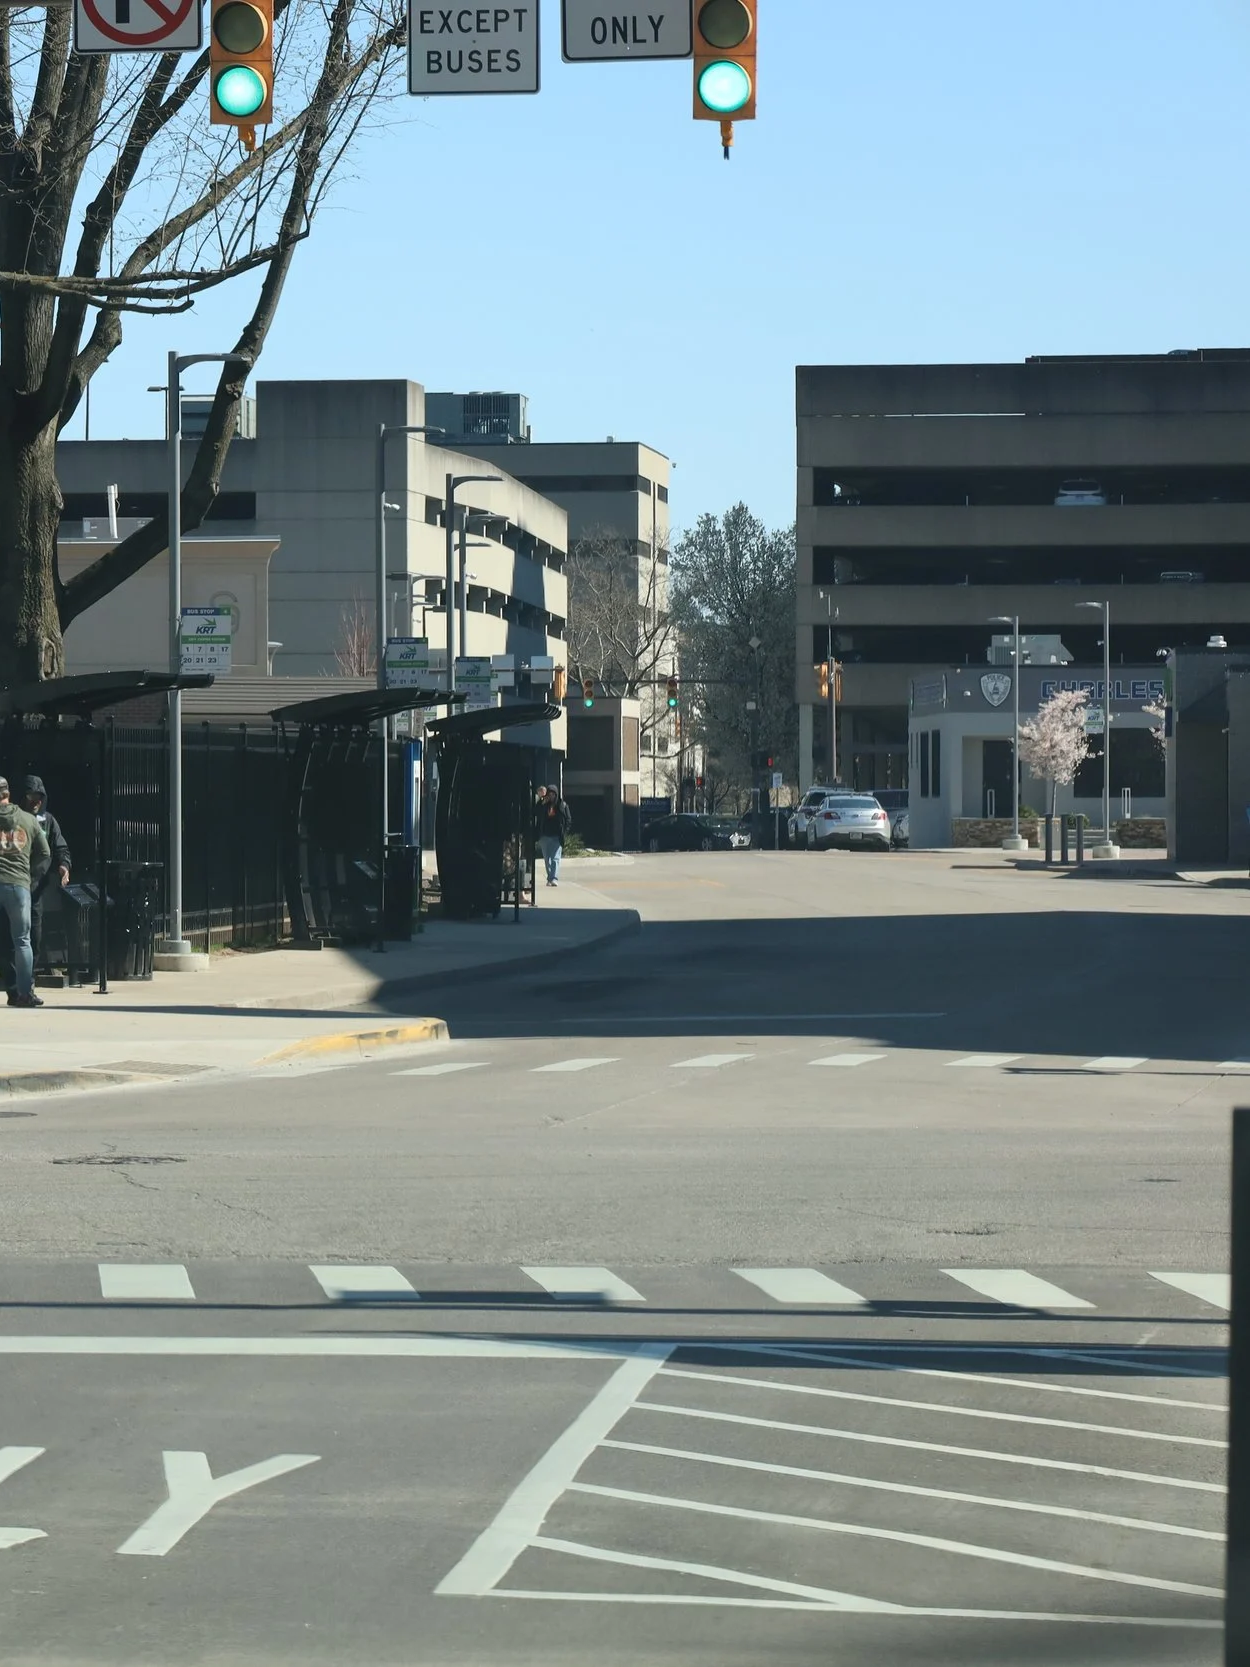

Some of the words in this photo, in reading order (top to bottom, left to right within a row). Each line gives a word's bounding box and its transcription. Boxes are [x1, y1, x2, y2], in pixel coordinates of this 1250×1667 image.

[419, 8, 528, 34] EXCEPT
[590, 14, 665, 45] ONLY
[426, 48, 521, 74] BUSES
[196, 626, 217, 634] KRT
